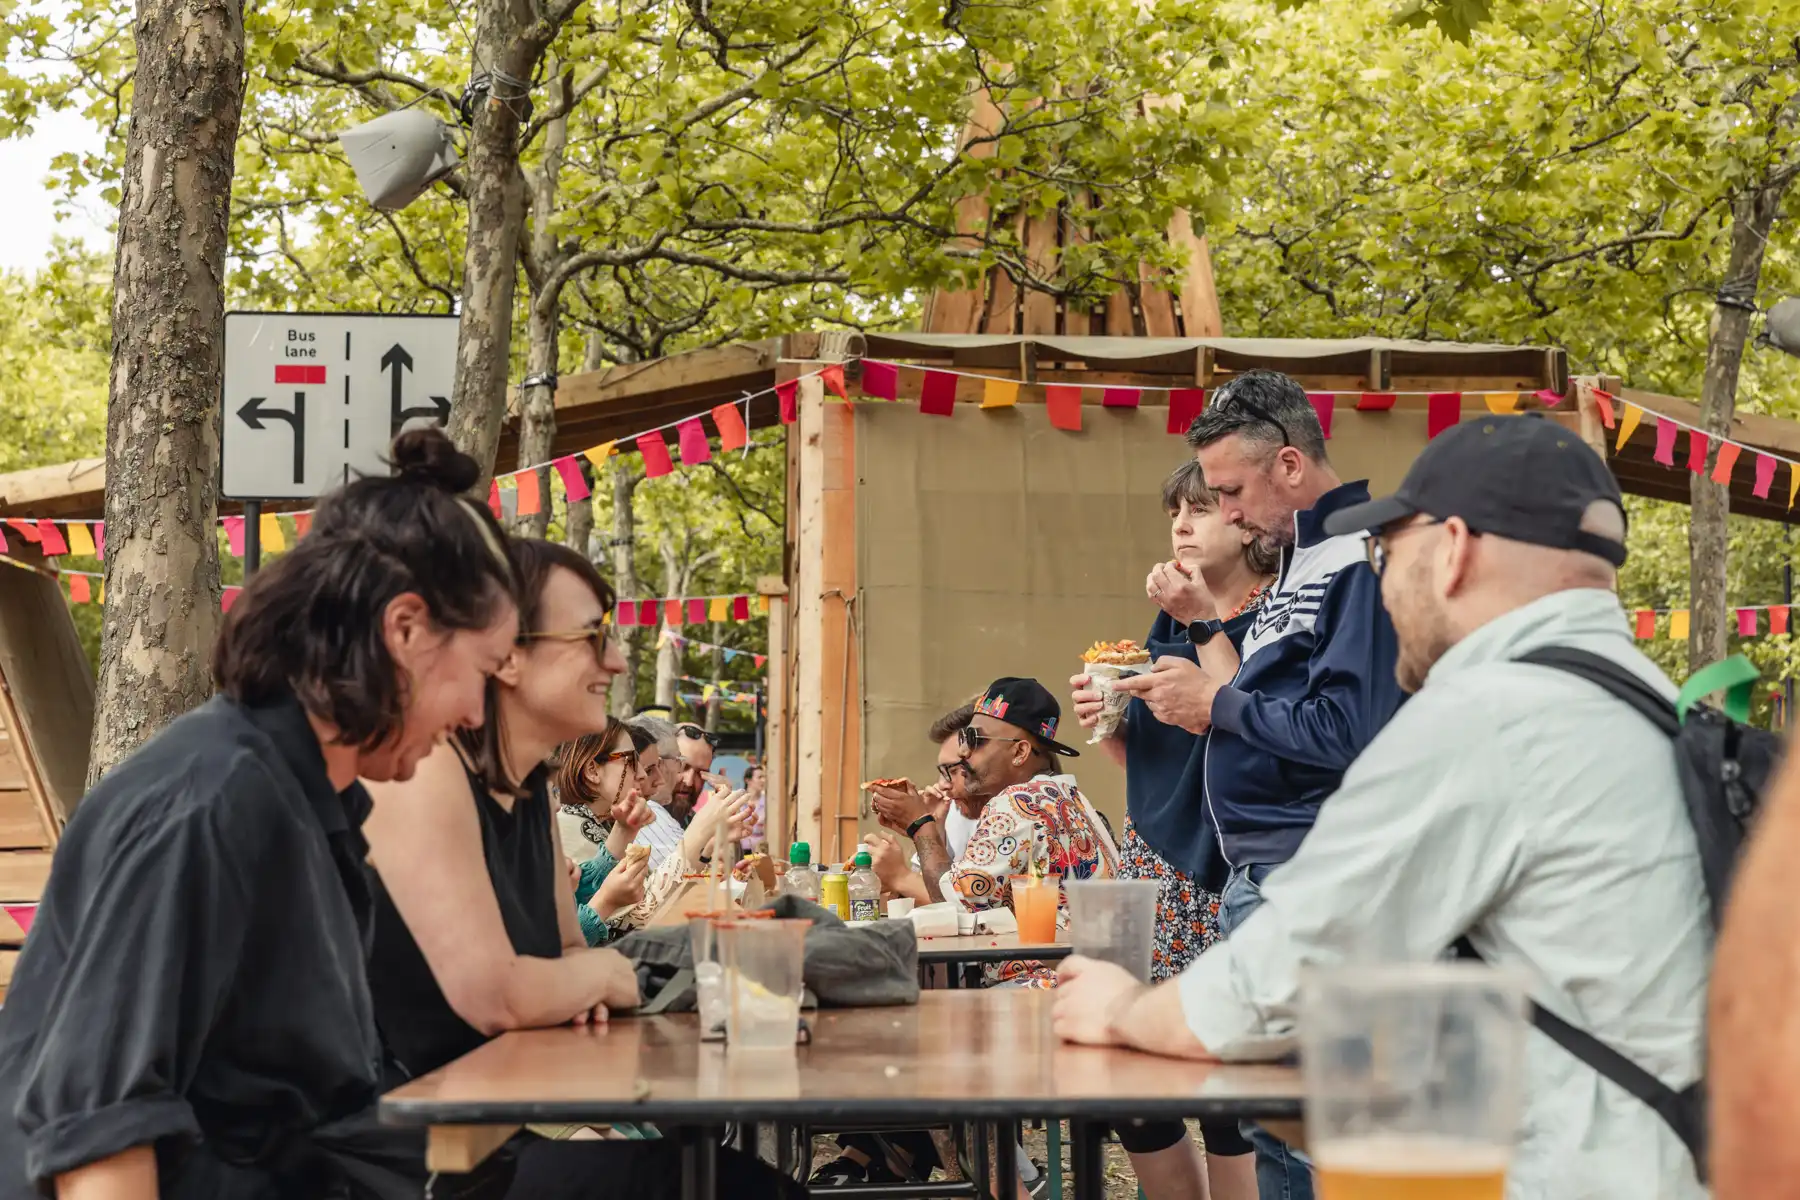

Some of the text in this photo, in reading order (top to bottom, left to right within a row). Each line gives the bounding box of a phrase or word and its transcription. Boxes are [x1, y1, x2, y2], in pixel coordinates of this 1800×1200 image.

[288, 329, 316, 342] Bus
[285, 345, 317, 358] lane
[857, 903, 872, 911] Fruit
